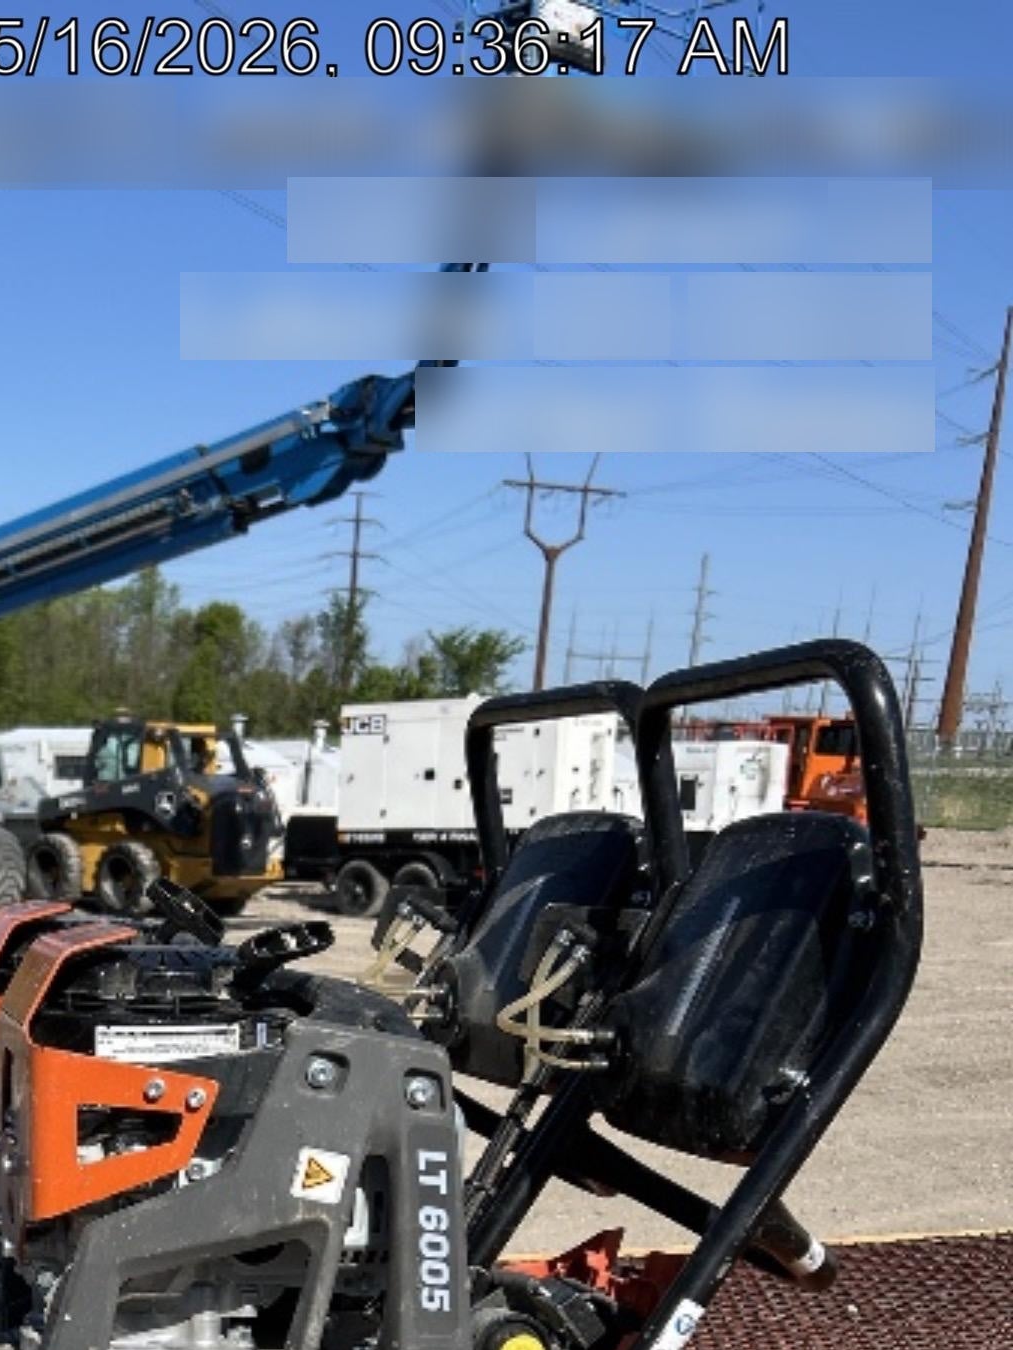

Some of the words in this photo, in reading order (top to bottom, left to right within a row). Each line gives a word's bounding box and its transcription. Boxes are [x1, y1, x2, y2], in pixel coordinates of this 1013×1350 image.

[340, 713, 387, 735] JCB
[417, 1150, 448, 1195] LT
[418, 1205, 451, 1312] 6005
